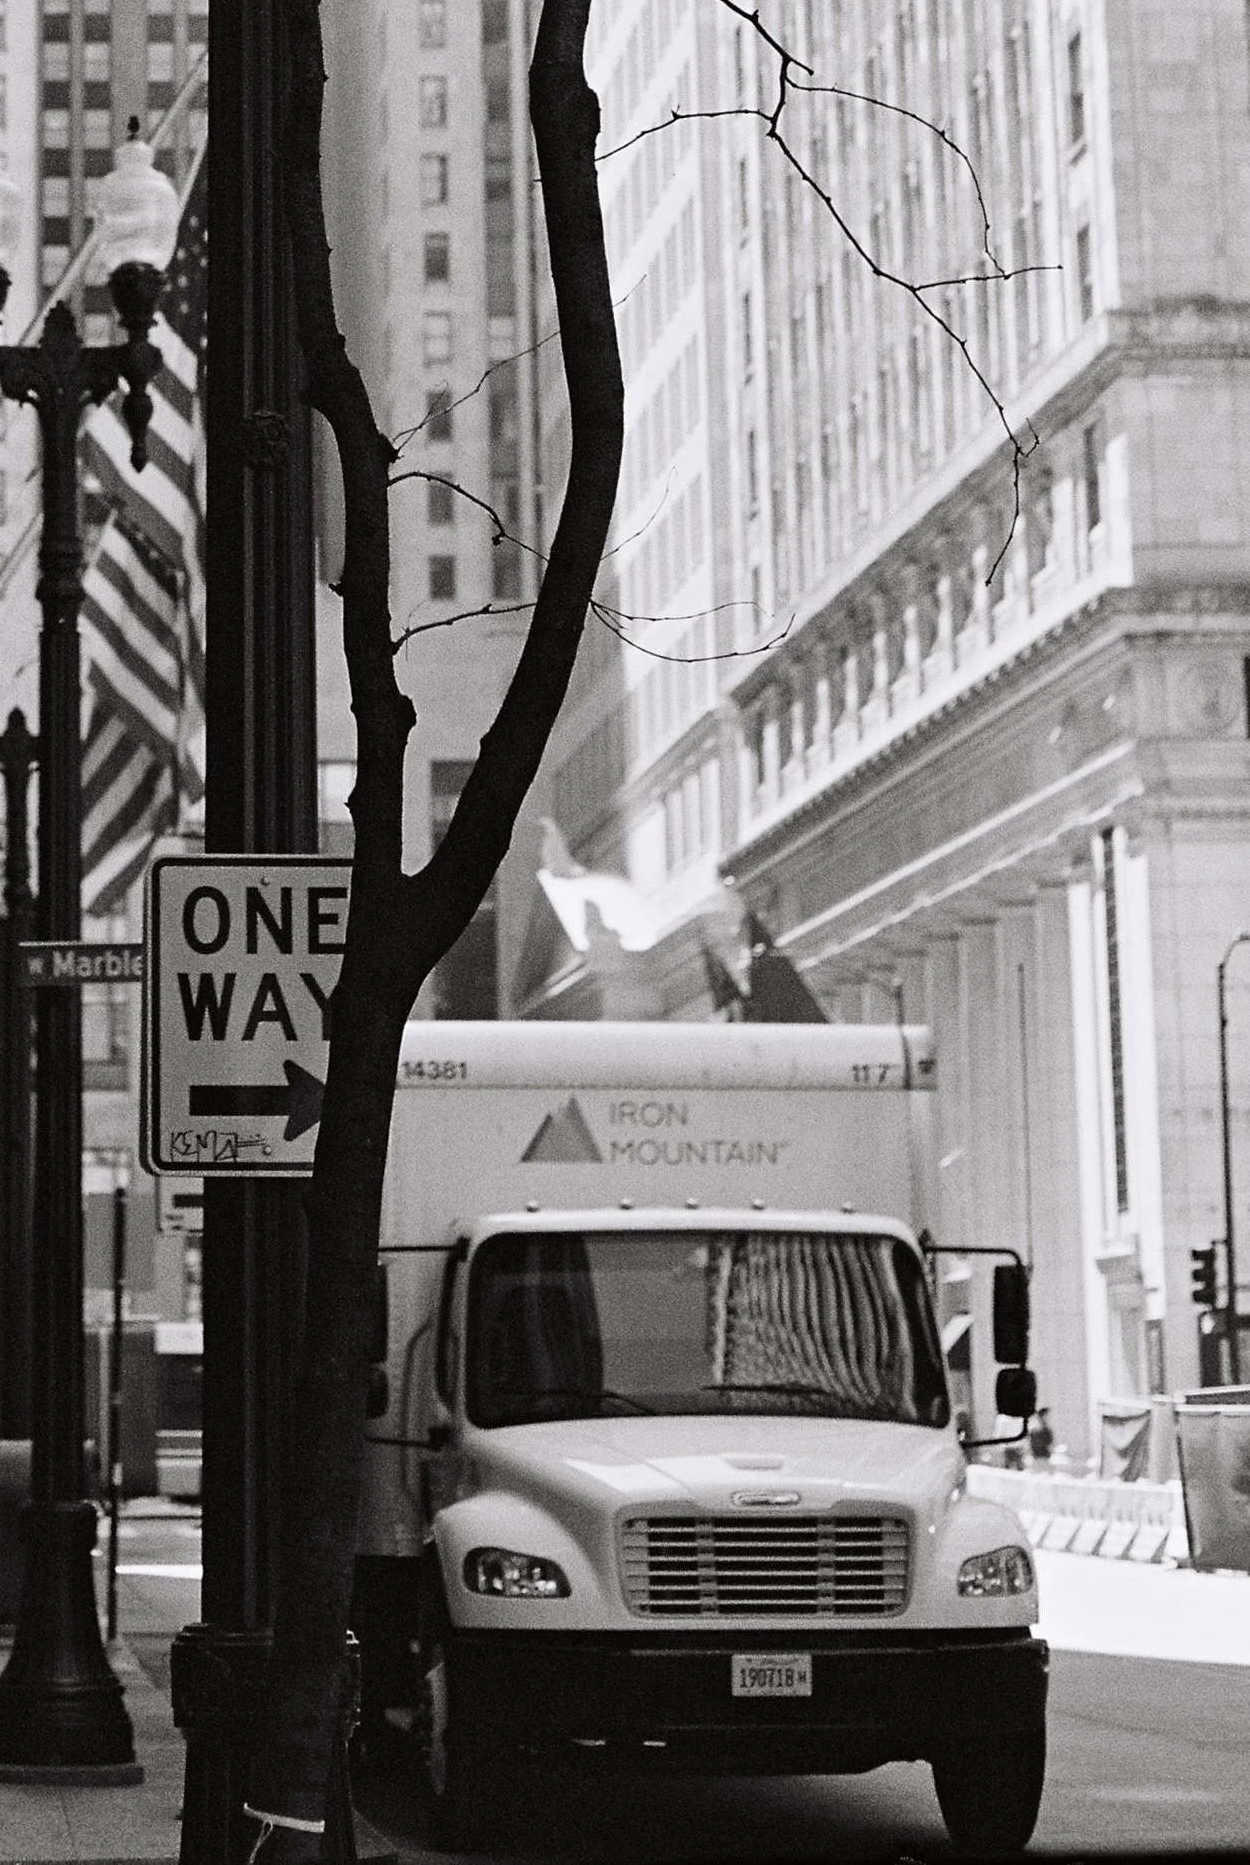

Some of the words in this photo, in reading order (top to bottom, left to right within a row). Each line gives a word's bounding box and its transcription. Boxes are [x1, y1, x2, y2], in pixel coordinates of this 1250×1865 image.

[182, 886, 348, 954] ONE
[401, 1060, 467, 1081] 14381
[608, 1101, 688, 1127] IRON
[609, 1138, 778, 1166] MOUNTAIN
